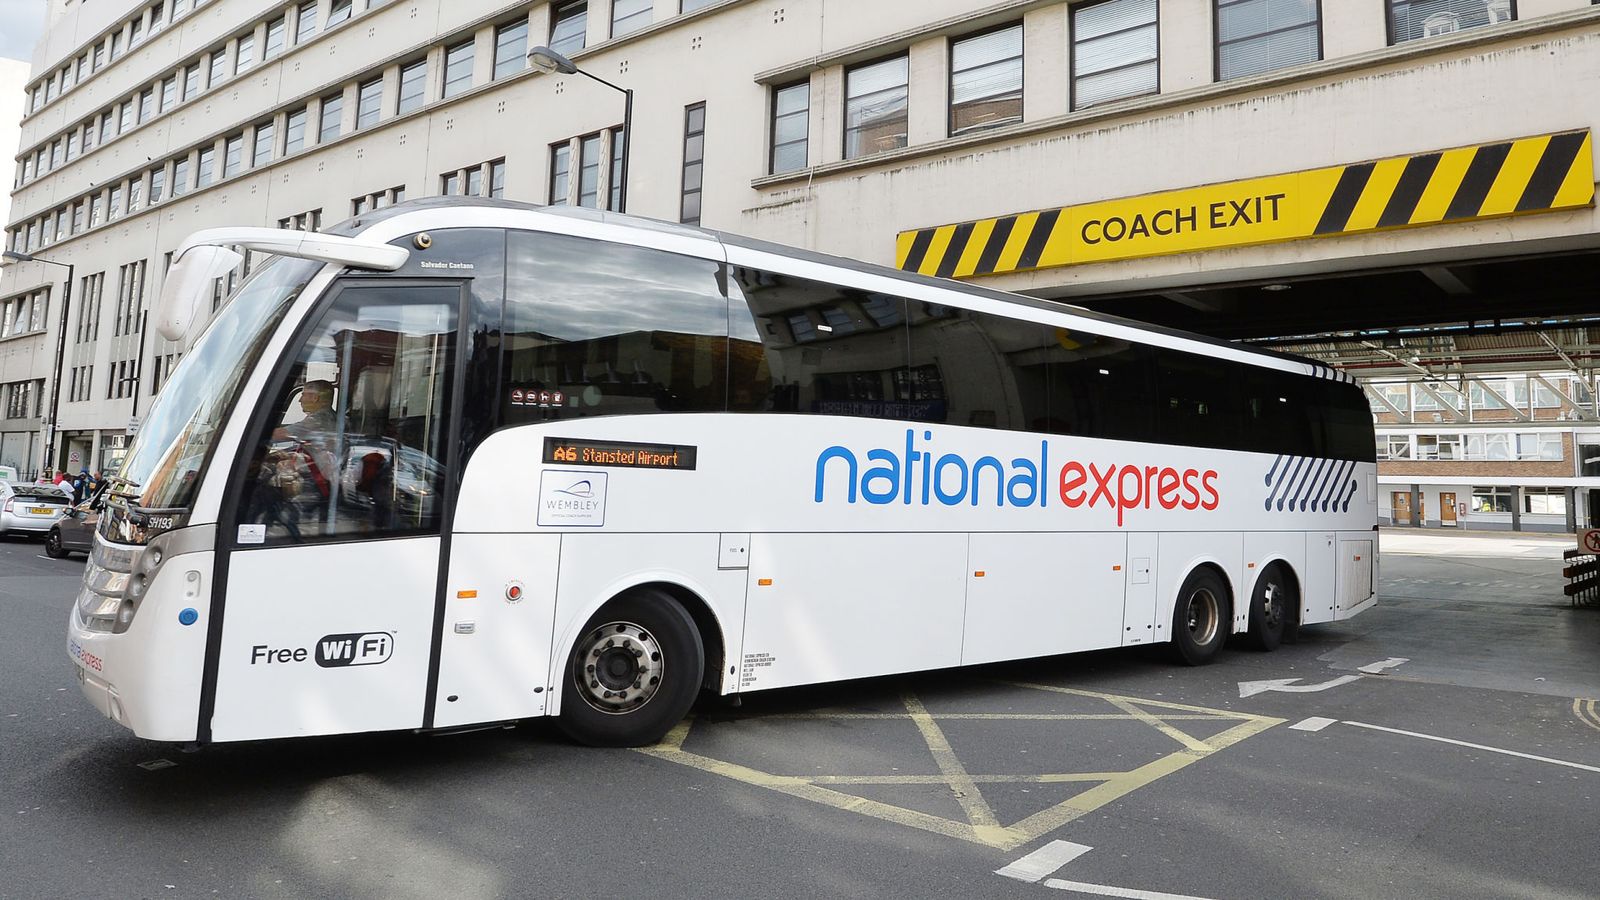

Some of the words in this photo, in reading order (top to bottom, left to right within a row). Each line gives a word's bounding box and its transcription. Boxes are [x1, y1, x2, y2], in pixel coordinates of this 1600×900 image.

[1081, 206, 1197, 245] COACH
[1210, 194, 1286, 229] EXIT
[420, 261, 448, 269] Salvador
[449, 262, 474, 270] Caetano
[553, 446, 577, 462] A6
[582, 447, 635, 464] Stansted
[638, 450, 678, 466] Airport
[814, 429, 1048, 508] national
[1059, 461, 1220, 527] express
[546, 500, 599, 510] WEMBLEY
[148, 517, 173, 529] SH193
[251, 645, 308, 665] Free
